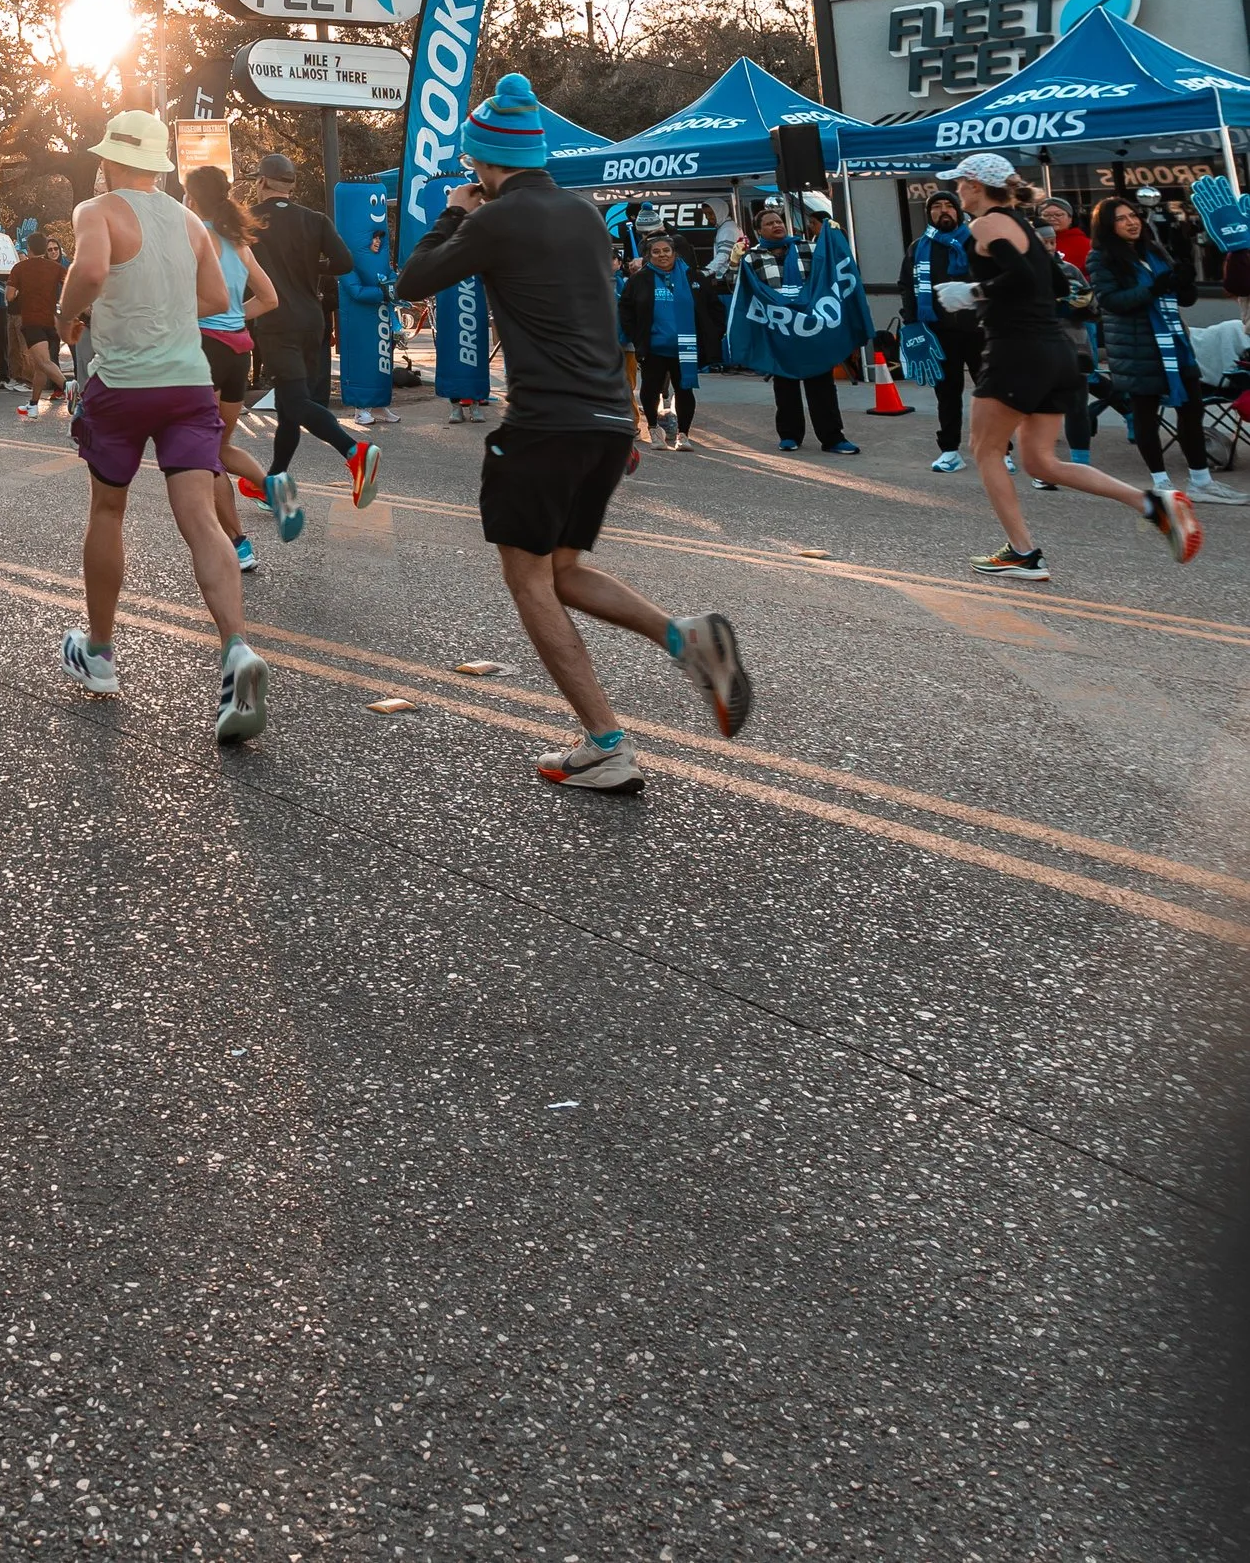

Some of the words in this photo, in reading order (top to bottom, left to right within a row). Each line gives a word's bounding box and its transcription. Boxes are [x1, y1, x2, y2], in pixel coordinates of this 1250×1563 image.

[248, 62, 283, 77] YOURE
[289, 66, 329, 81] ALMOST
[335, 70, 368, 84] THERE
[303, 53, 328, 67] MILE
[335, 56, 342, 68] 7
[907, 35, 1055, 95] FEET
[371, 87, 402, 100] KINDA
[983, 83, 1138, 110] BROOKS
[643, 116, 748, 138] BROOKS
[935, 109, 1088, 148] BROOKS
[602, 153, 700, 181] BROOKS
[458, 275, 478, 367] BROOK
[378, 304, 391, 375] BROO
